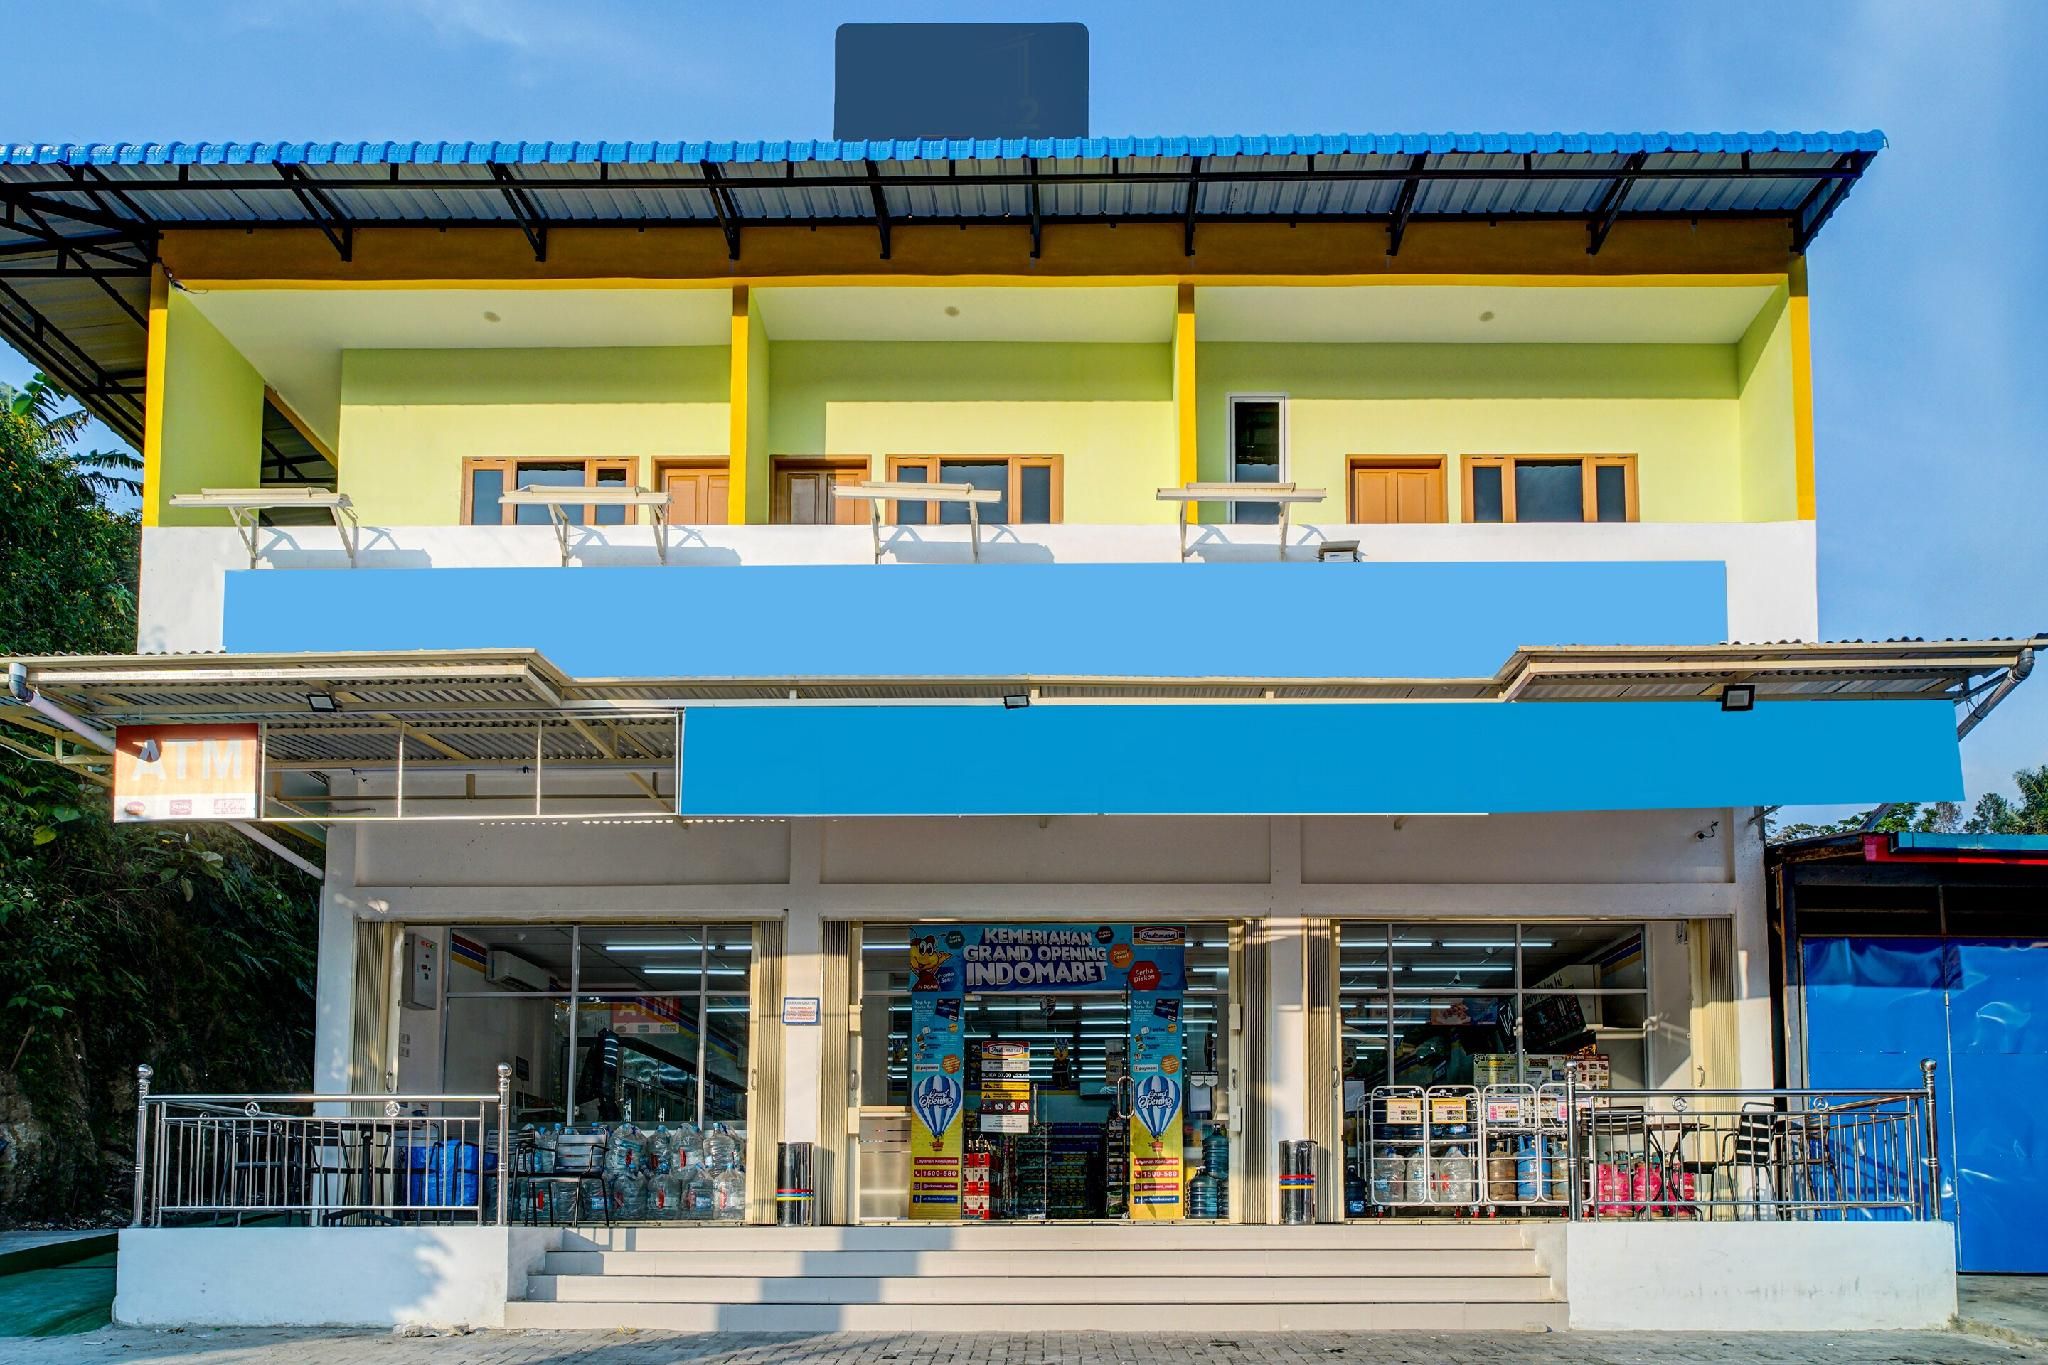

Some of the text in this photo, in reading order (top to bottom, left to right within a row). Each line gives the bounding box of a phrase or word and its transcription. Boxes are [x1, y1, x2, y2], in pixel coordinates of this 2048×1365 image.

[131, 738, 242, 781] ATM
[984, 927, 1092, 945] KEMERIAHAN
[963, 945, 1033, 962] GRAND
[1038, 946, 1107, 961] OPENING
[966, 961, 1108, 986] INDOMARET
[1135, 968, 1154, 976] Serba
[919, 1095, 954, 1109] Opening
[1138, 1095, 1173, 1109] Opening
